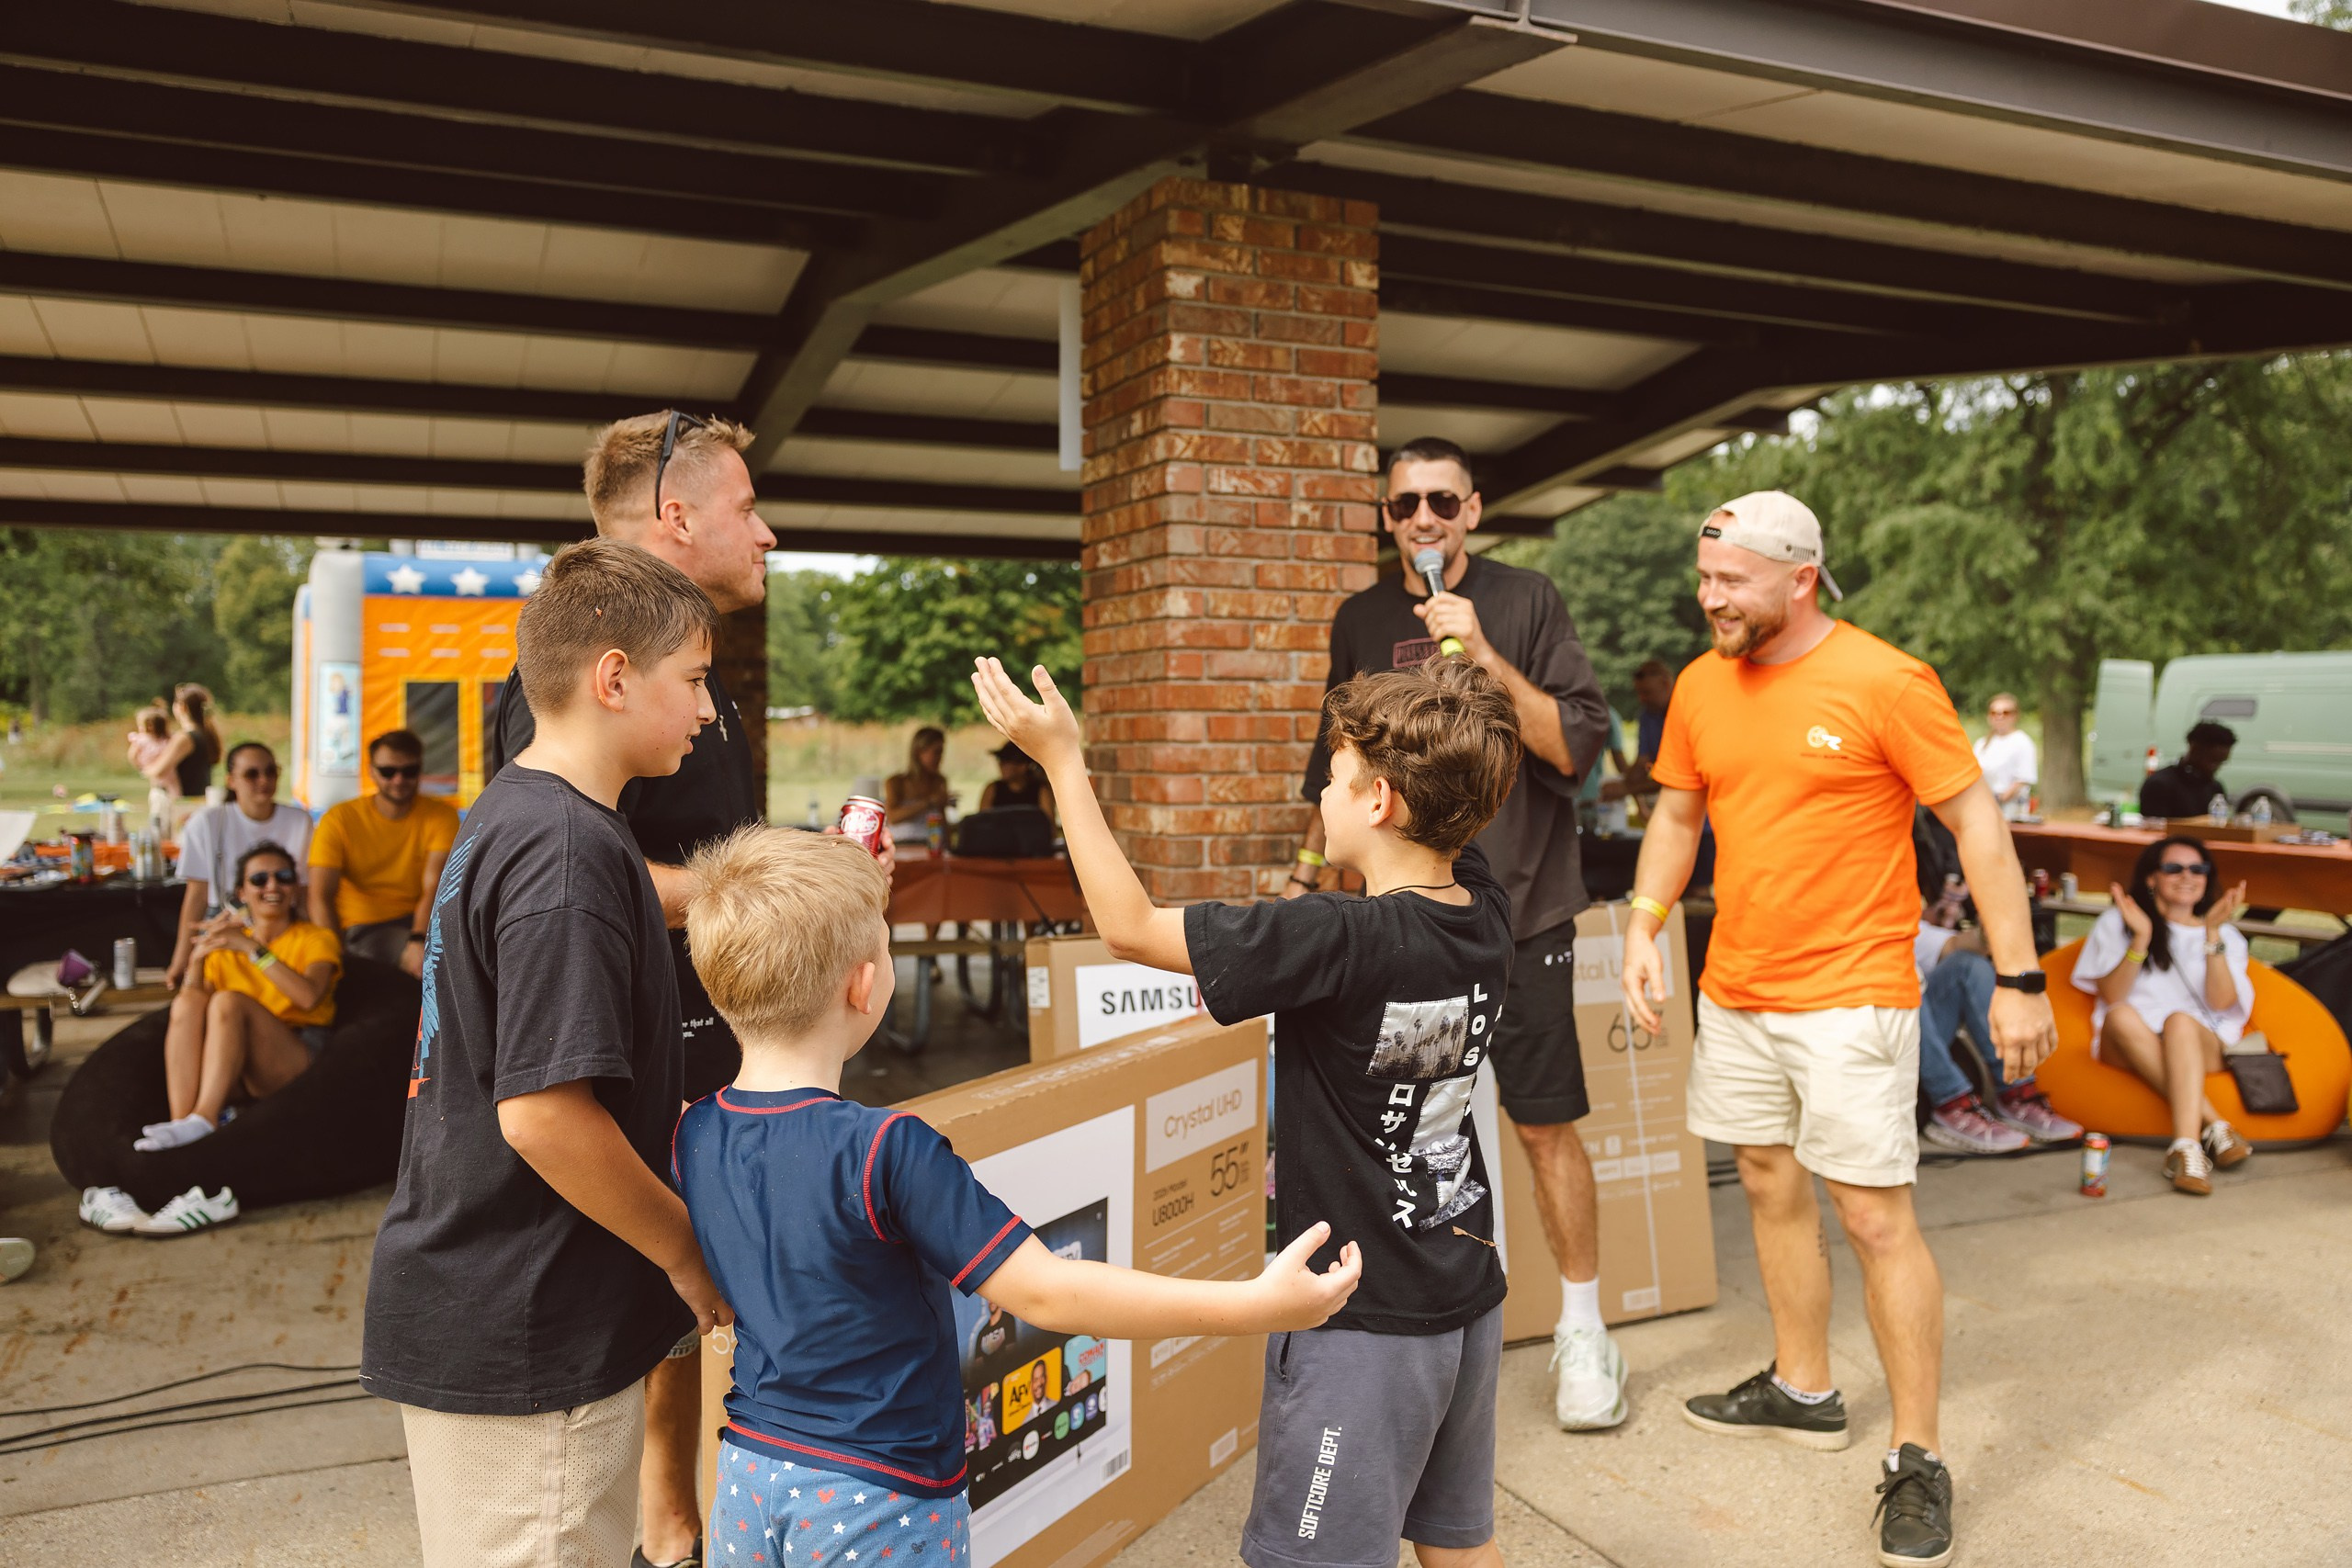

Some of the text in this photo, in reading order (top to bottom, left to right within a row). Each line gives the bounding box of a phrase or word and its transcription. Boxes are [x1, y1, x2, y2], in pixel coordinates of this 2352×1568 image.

[1102, 986, 1202, 1015] SAMSU
[1463, 983, 1488, 1066] LOS
[1164, 1089, 1242, 1139] Crystal UHD
[1298, 1426, 1342, 1540] SOFTCORE DEPT.
